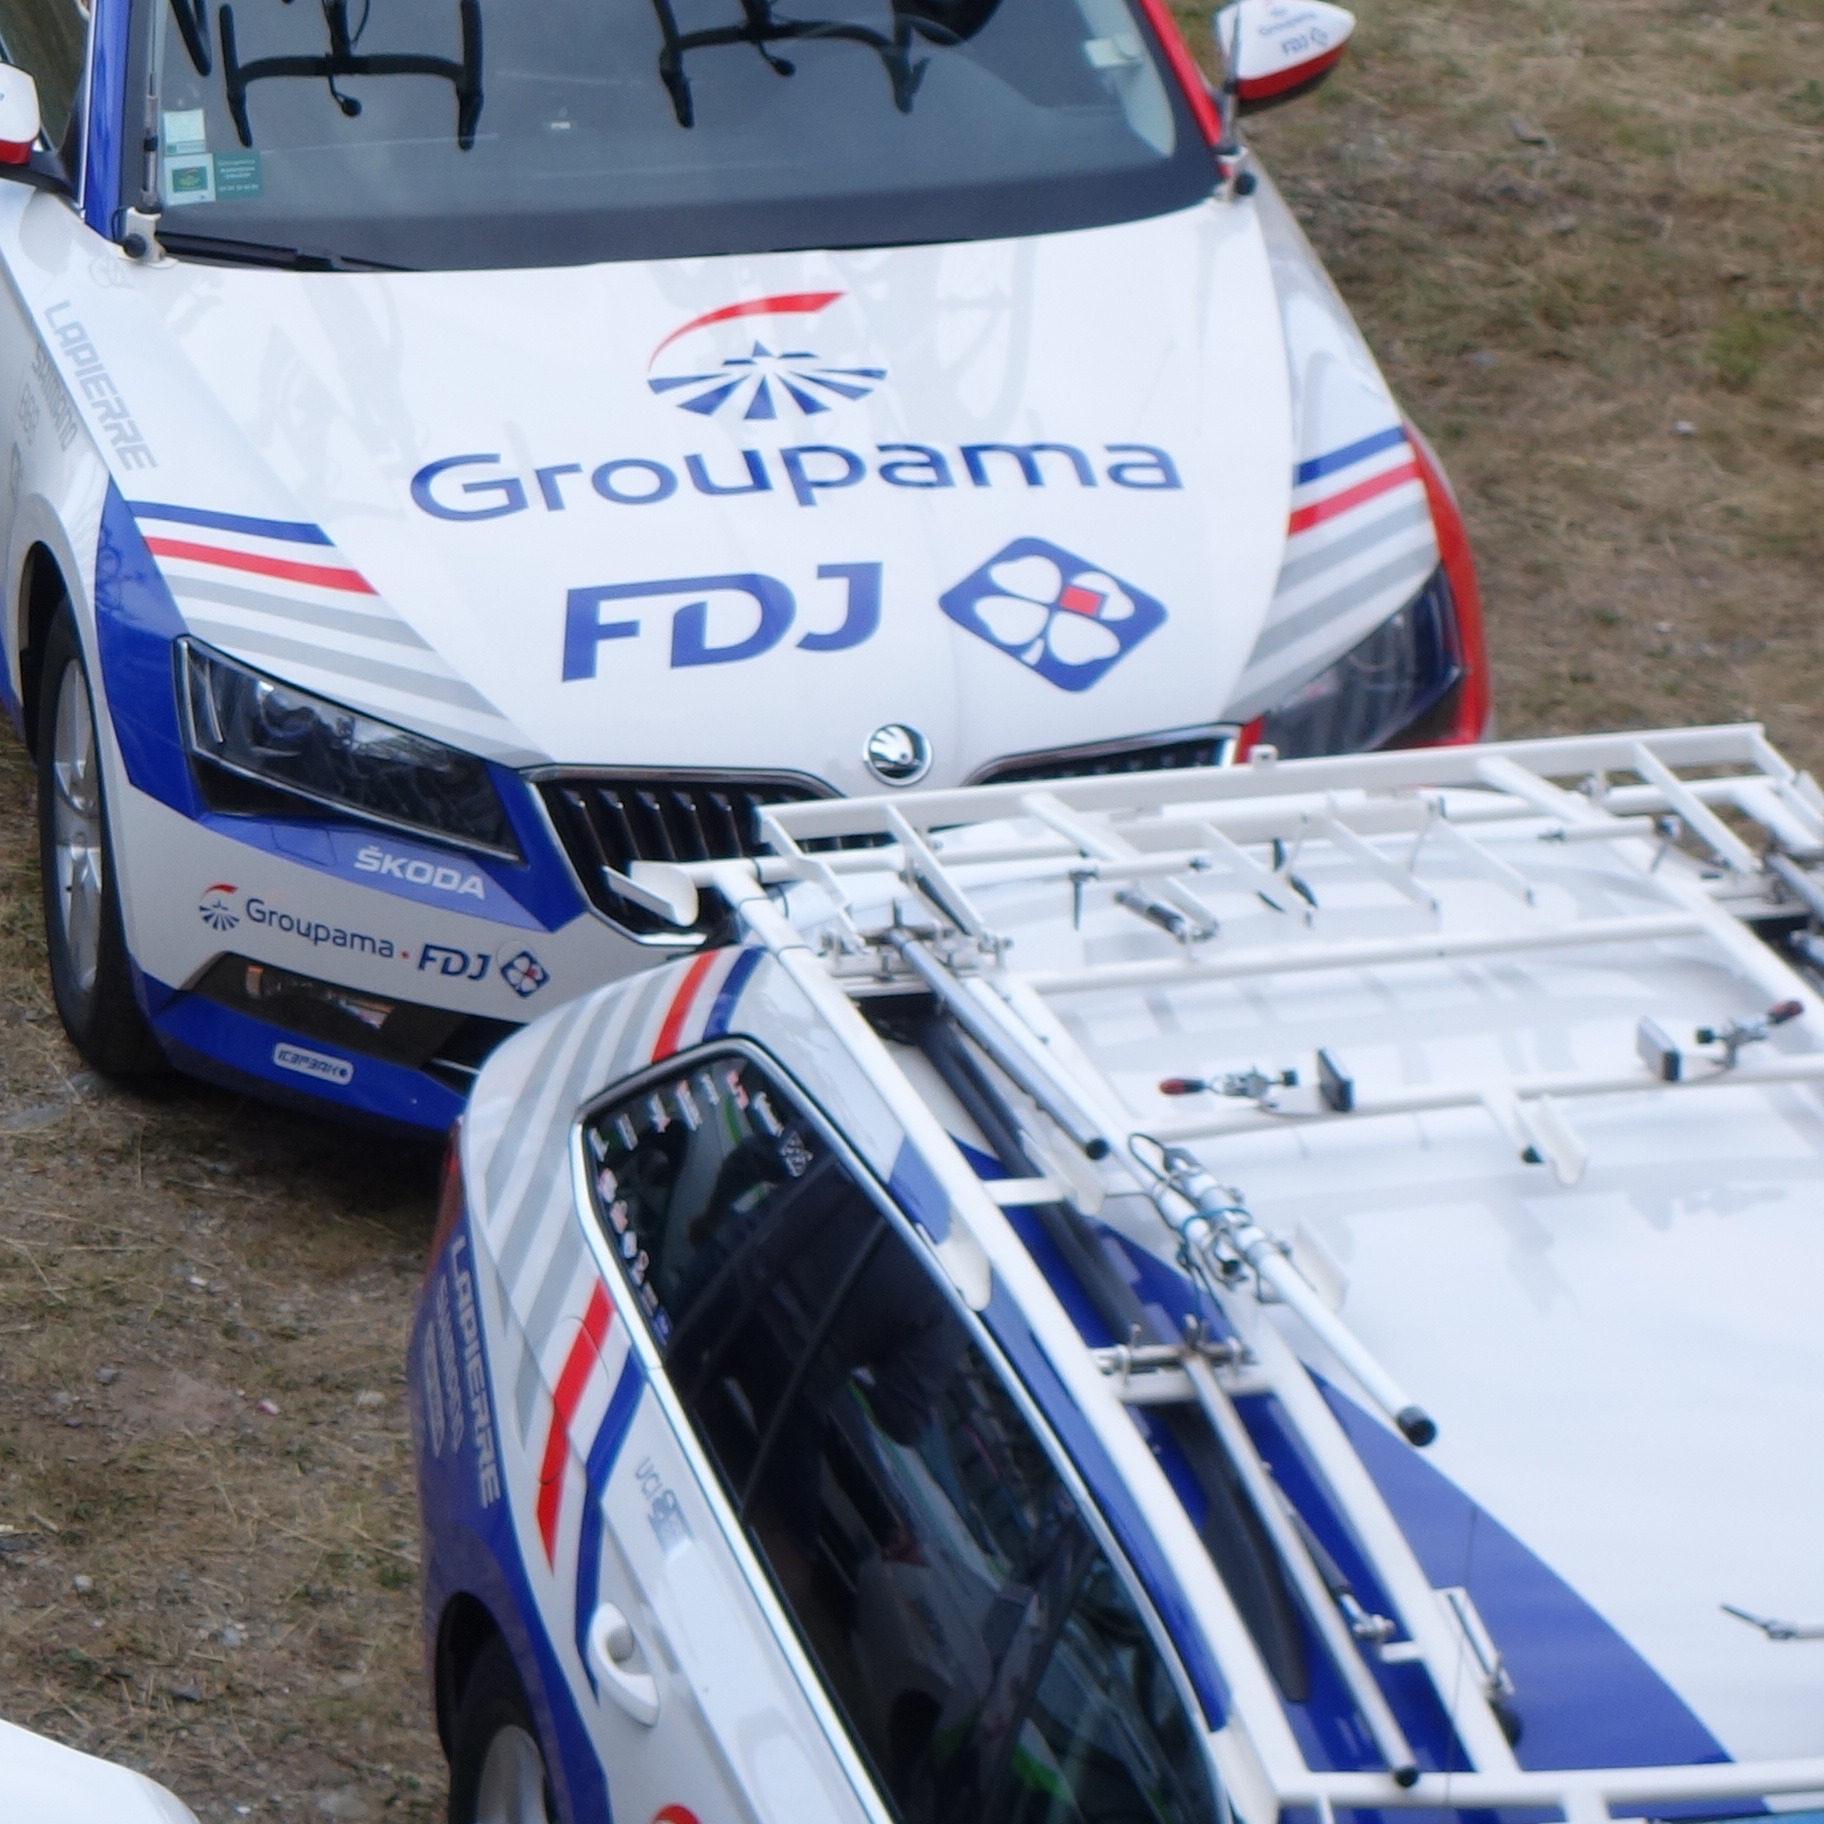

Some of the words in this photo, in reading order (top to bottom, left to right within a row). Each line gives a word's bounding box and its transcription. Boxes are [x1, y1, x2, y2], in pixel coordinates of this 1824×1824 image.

[44, 299, 159, 472] LAPIERRE
[410, 440, 1184, 523] Groupama
[561, 560, 885, 683] FDJ
[355, 845, 487, 901] ŠKODA
[245, 898, 395, 960] Groupama
[417, 943, 491, 982] FDJ
[453, 1234, 502, 1509] LAPIERRE
